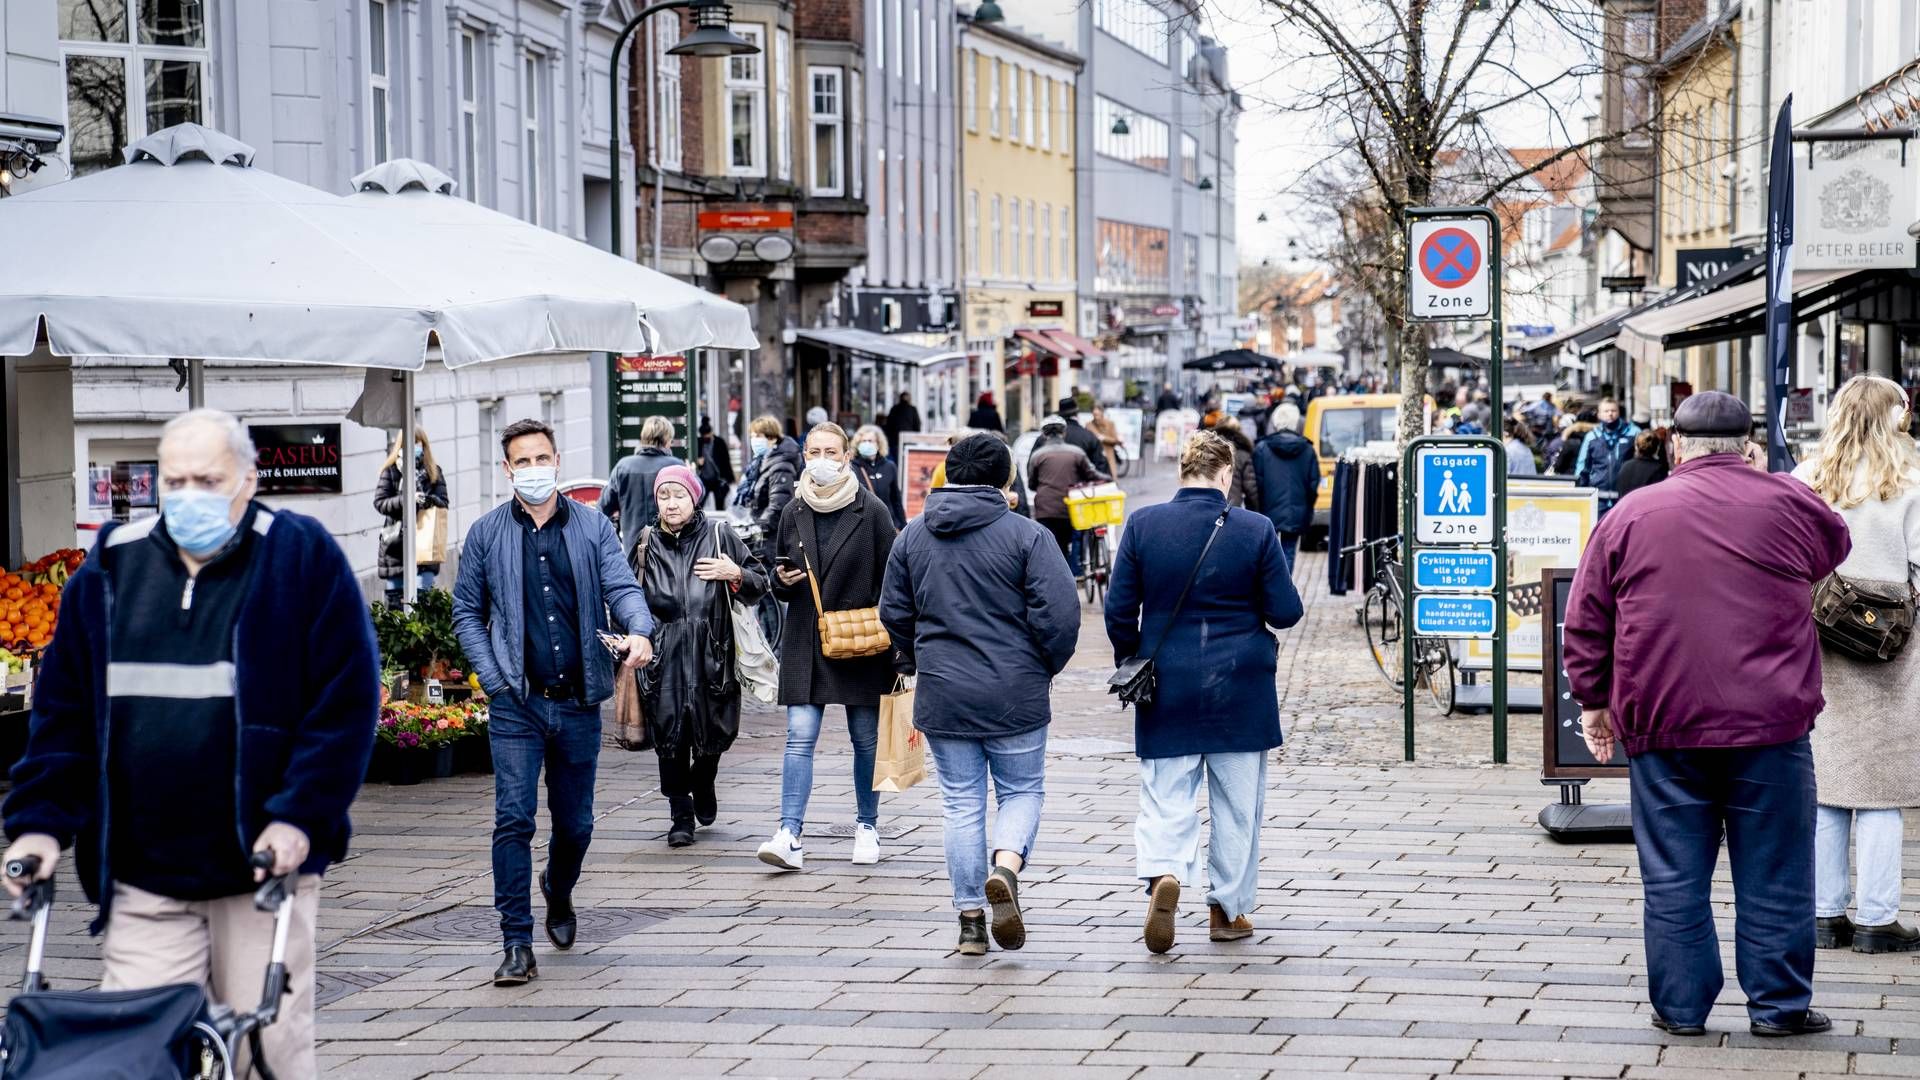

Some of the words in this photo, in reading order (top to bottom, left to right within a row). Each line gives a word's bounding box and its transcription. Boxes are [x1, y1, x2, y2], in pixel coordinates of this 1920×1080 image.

[1806, 243, 1853, 257] PETER
[1859, 242, 1904, 256] BEIER
[1428, 295, 1473, 308] Zone
[659, 382, 683, 393] TATTOO
[256, 444, 337, 466] CASEUS
[1433, 456, 1477, 468] Gågade
[274, 467, 281, 477] &
[283, 467, 338, 477] DELIKATESSER
[1433, 521, 1477, 534] Zone
[1421, 556, 1456, 566] Cykling
[1460, 556, 1489, 565] tilladt
[1433, 566, 1450, 574] alle
[1454, 566, 1476, 576] dage
[1442, 576, 1468, 584] 18-10
[1425, 610, 1485, 618] handicapkørsel
[1421, 618, 1445, 626] tilladt
[1448, 618, 1466, 626] 4-12
